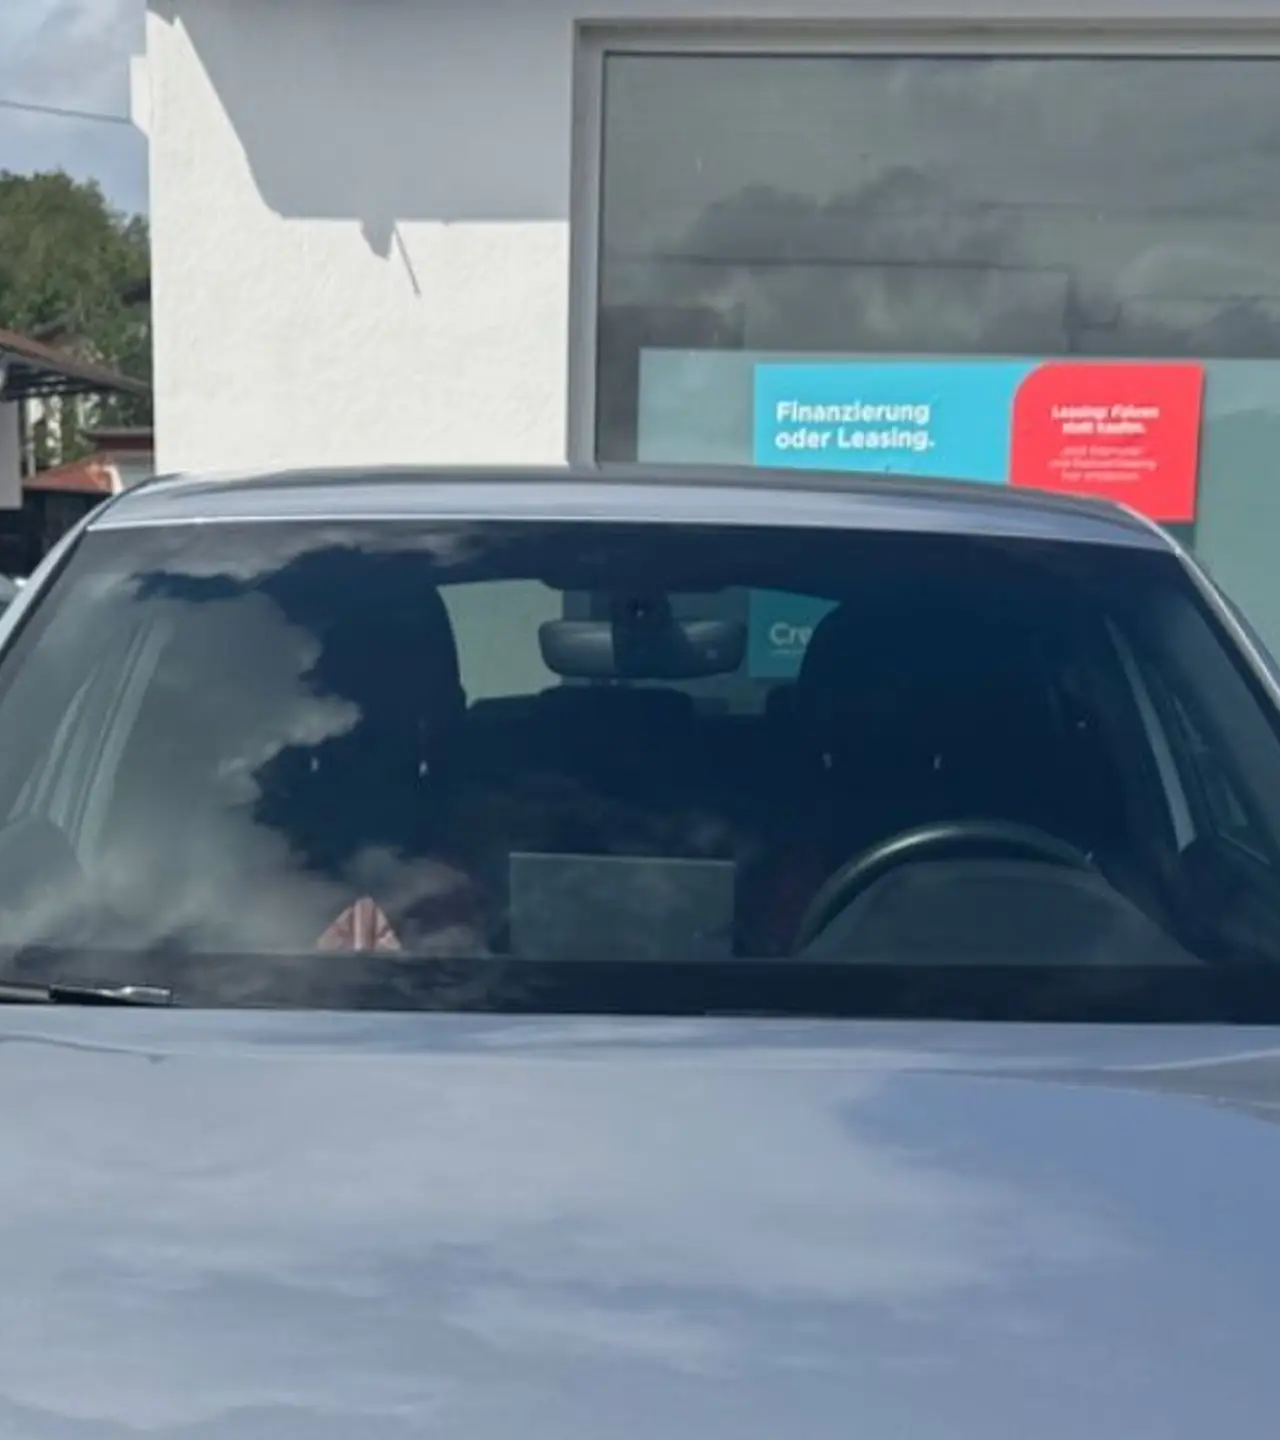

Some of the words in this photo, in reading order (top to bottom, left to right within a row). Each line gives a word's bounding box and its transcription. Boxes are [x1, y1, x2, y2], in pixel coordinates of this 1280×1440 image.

[776, 399, 930, 425] Finanzierung
[774, 428, 832, 450] oder
[837, 427, 936, 452] Leasing.
